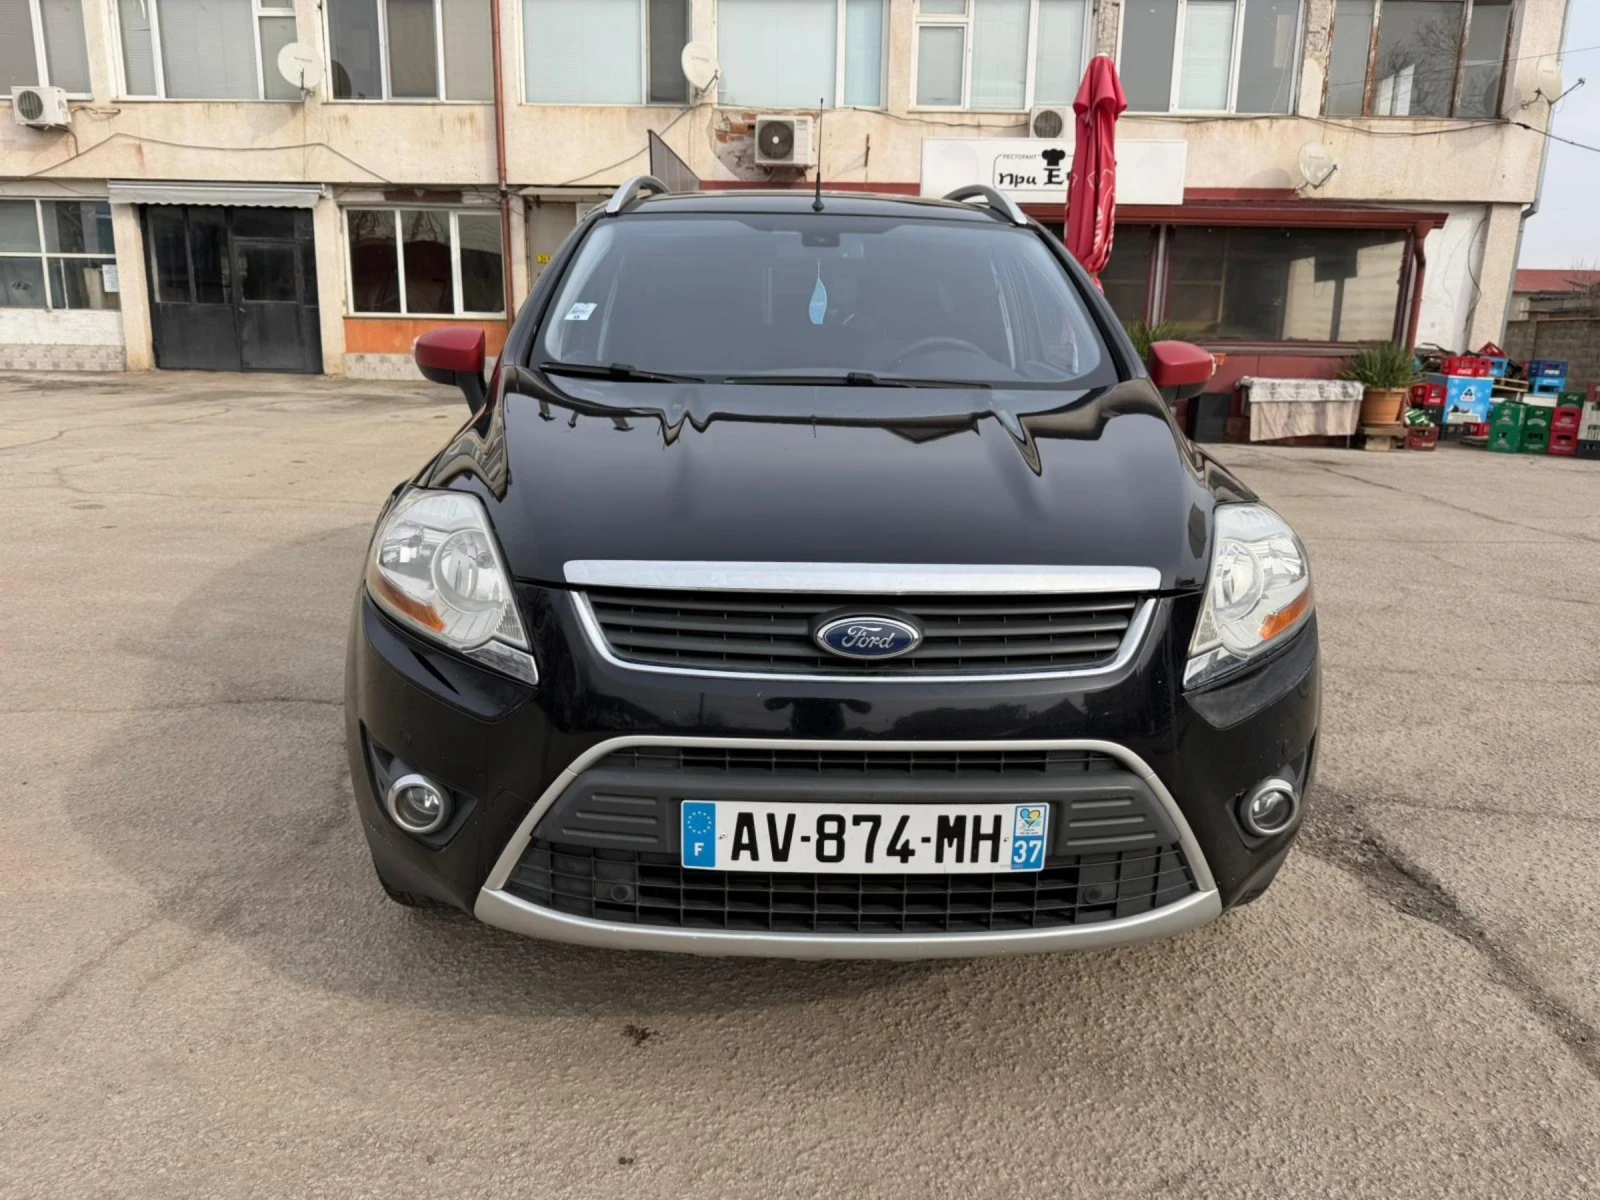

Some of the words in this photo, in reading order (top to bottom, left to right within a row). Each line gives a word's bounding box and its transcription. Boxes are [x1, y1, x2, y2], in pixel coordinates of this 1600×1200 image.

[841, 625, 896, 649] Ford
[694, 842, 705, 856] F
[730, 811, 1003, 864] AV-874-MH
[1013, 839, 1042, 864] 37
